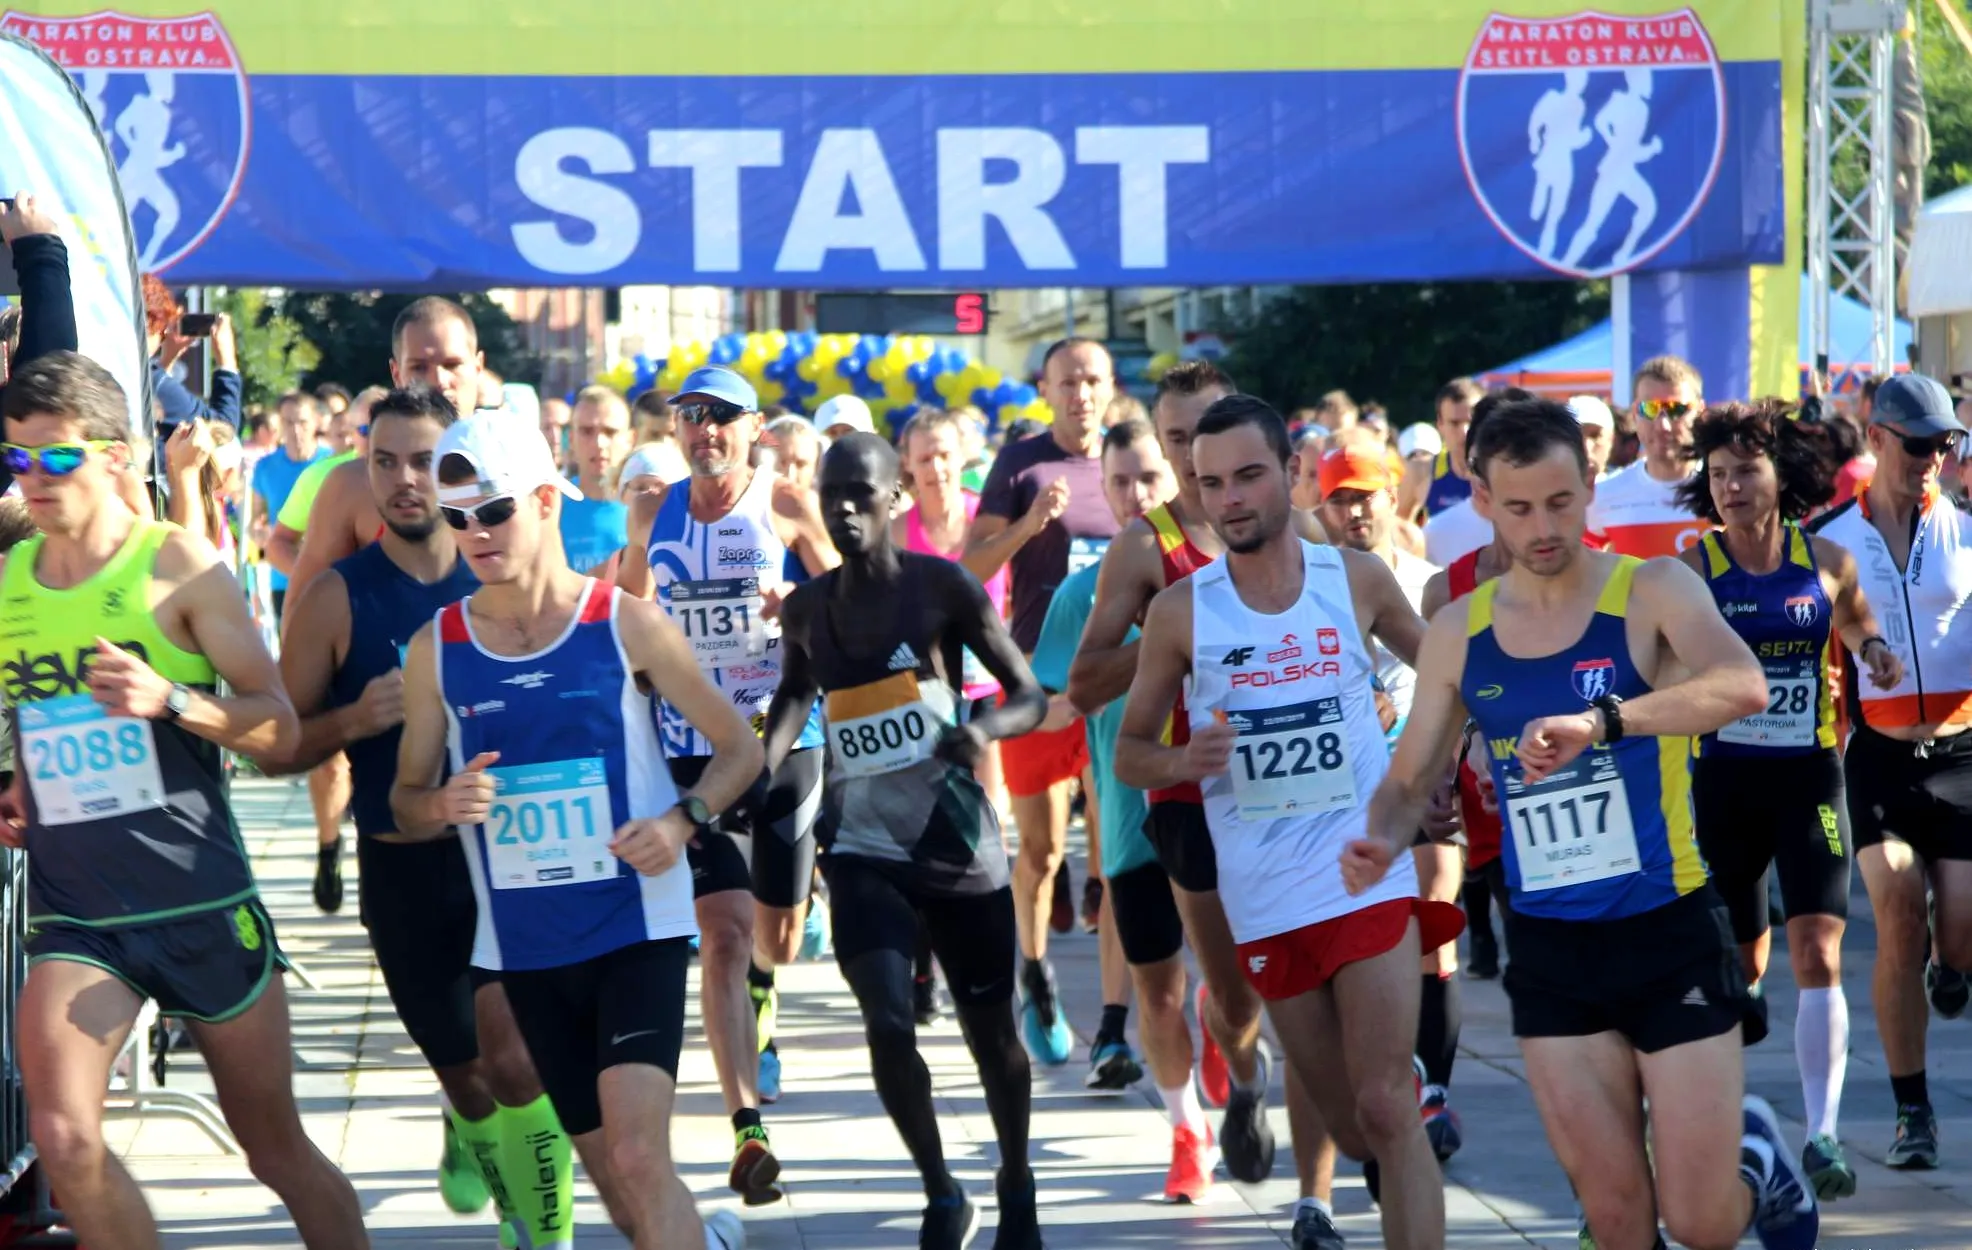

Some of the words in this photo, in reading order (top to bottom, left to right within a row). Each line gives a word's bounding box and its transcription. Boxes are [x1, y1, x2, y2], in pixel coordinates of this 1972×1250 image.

[7, 24, 132, 41] MARATON
[147, 24, 216, 41] KLUB
[1488, 24, 1612, 42] MARATON
[1626, 21, 1693, 39] KLUB
[85, 48, 206, 65] OSTRAVA
[1480, 49, 1553, 66] SEITL
[1566, 46, 1684, 65] OSTRAVA
[510, 126, 1210, 274] START
[680, 604, 750, 638] 1131
[695, 640, 740, 650] PAZDERA
[1759, 641, 1815, 657] SEITL
[1231, 661, 1340, 690] POLSKA
[1767, 685, 1809, 716] 28
[838, 710, 925, 759] 8800
[31, 723, 148, 781] 2088
[1235, 731, 1344, 781] 1228
[491, 796, 596, 845] 2011
[1516, 790, 1612, 847] 1117
